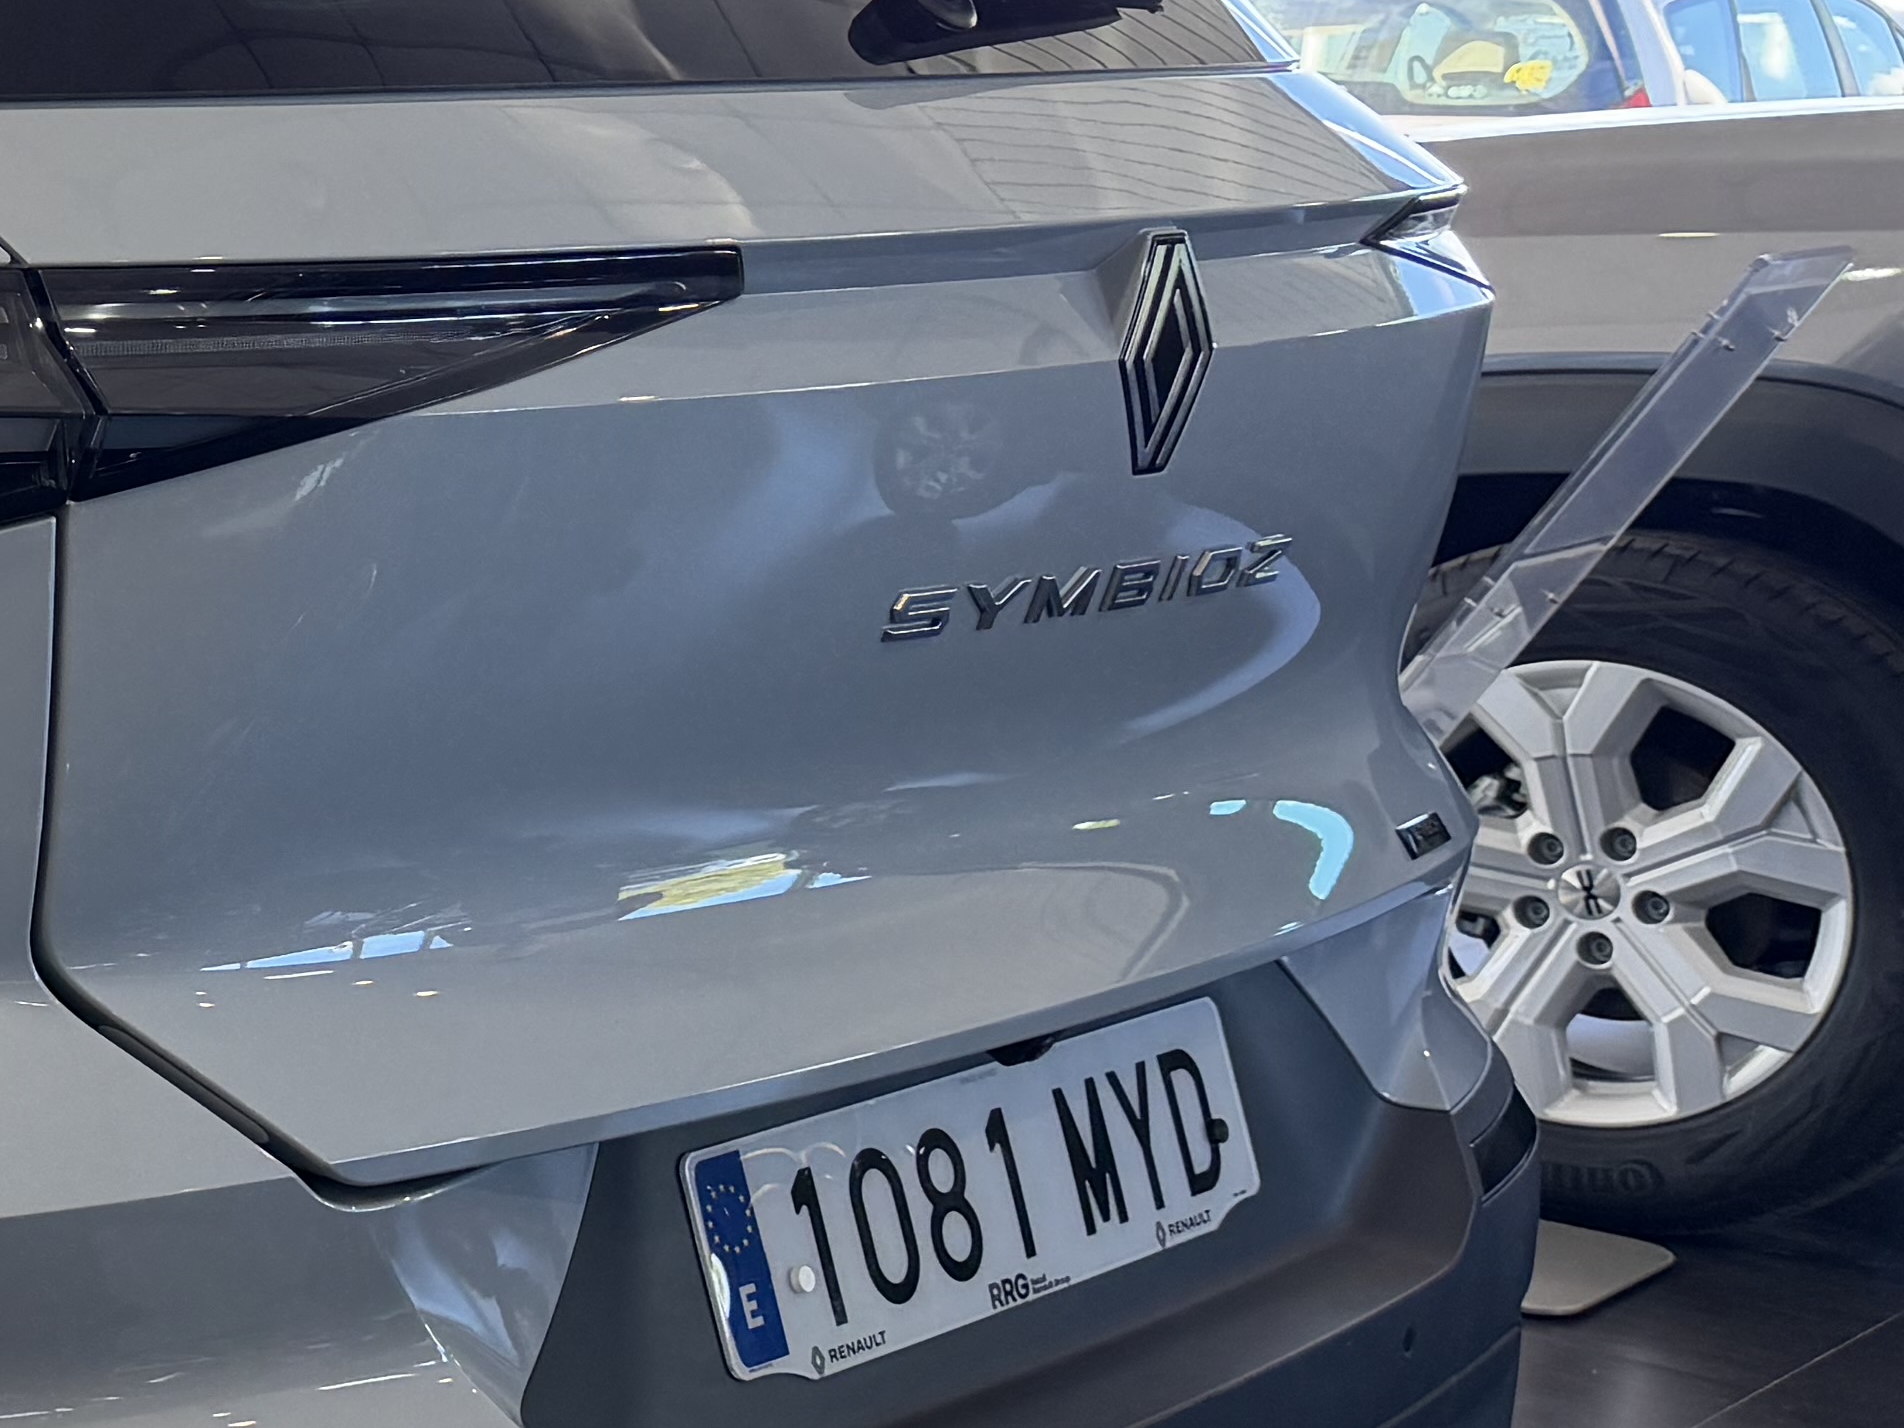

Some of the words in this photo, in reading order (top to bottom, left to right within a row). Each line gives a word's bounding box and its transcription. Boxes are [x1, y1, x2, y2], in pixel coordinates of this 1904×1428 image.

[880, 534, 1292, 642] SYMBIOZ
[791, 1107, 1037, 1326] 1081
[1052, 1049, 1222, 1236] MYD
[1167, 1209, 1211, 1236] RENAULT
[739, 1283, 765, 1329] E
[988, 1273, 1030, 1310] RRG
[828, 1330, 887, 1364] RENAULT
